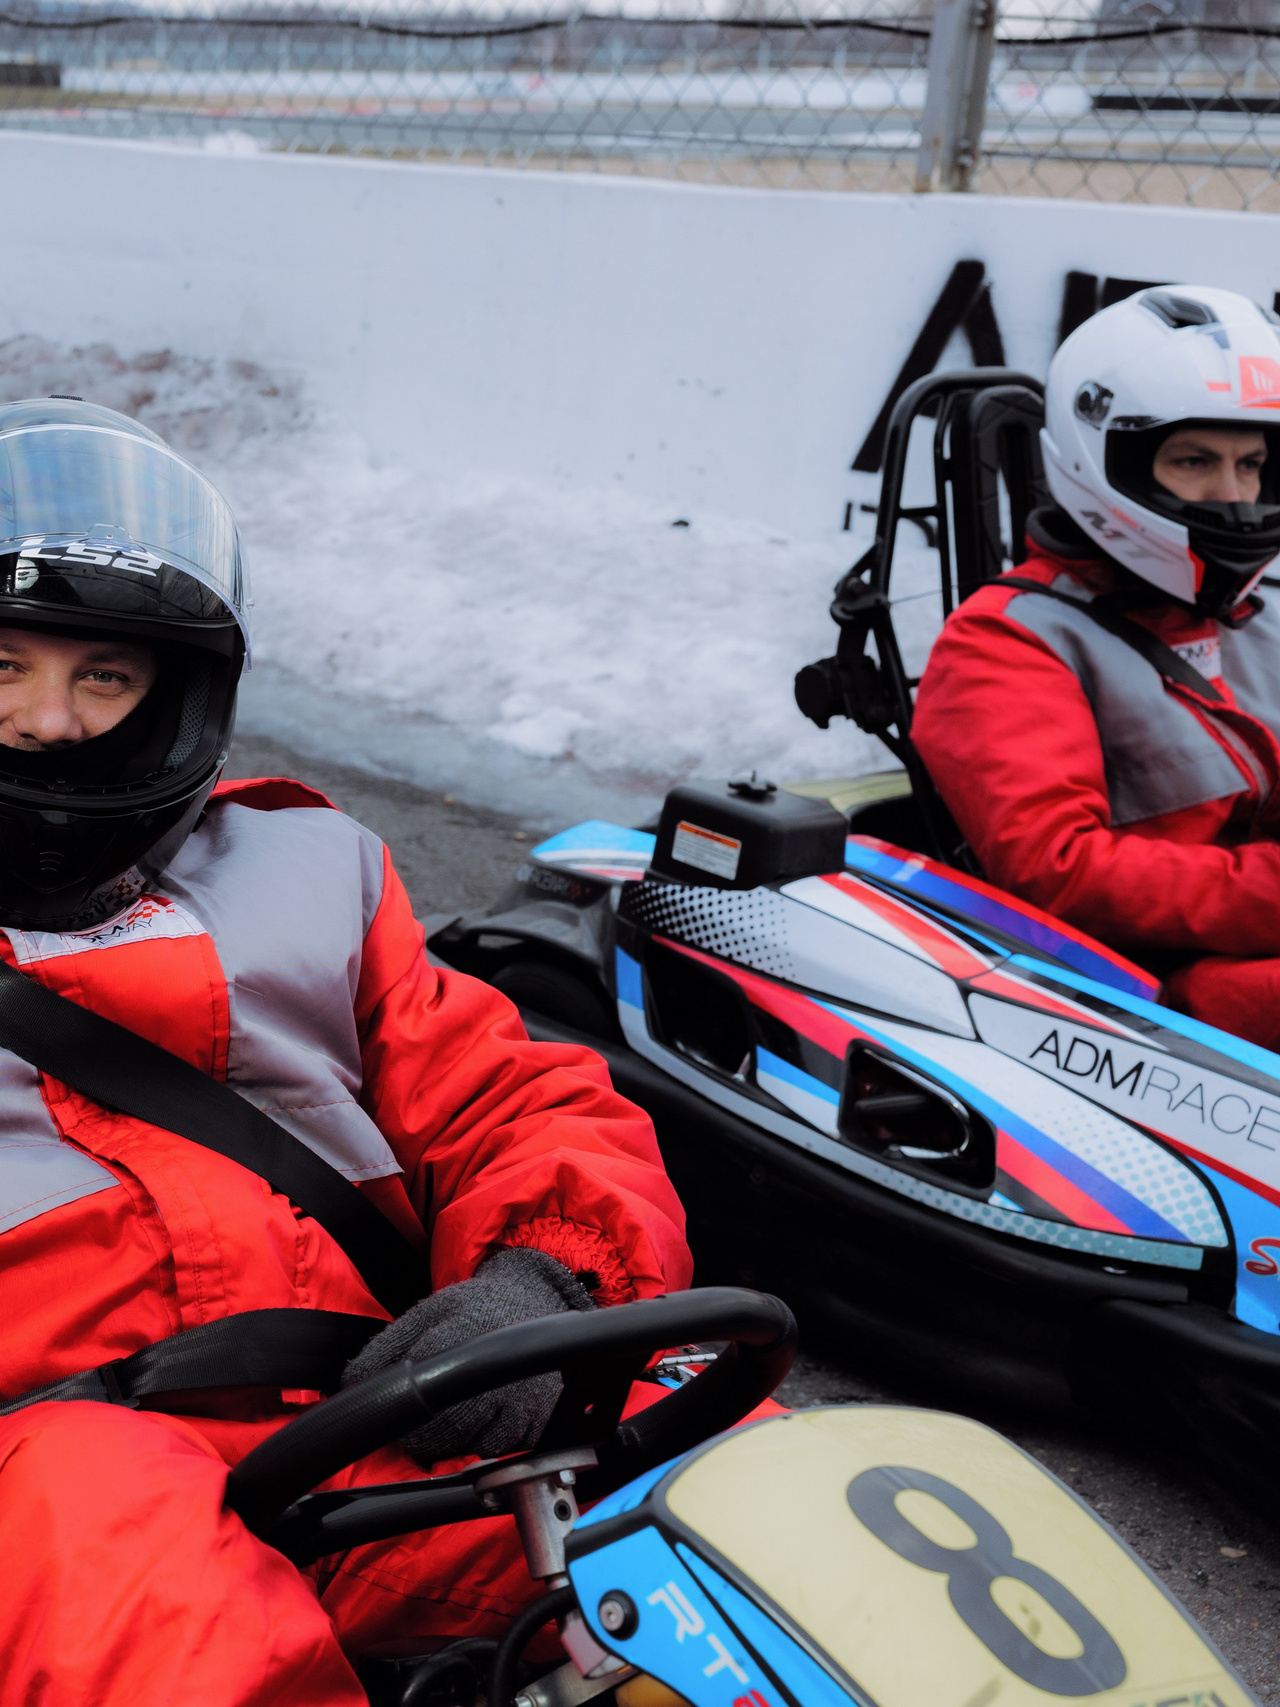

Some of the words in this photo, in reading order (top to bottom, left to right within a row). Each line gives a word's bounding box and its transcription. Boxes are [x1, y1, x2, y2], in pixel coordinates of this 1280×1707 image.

[20, 537, 163, 577] LS2
[1029, 1029, 1280, 1151] ADMRACE
[847, 1466, 1127, 1695] 8
